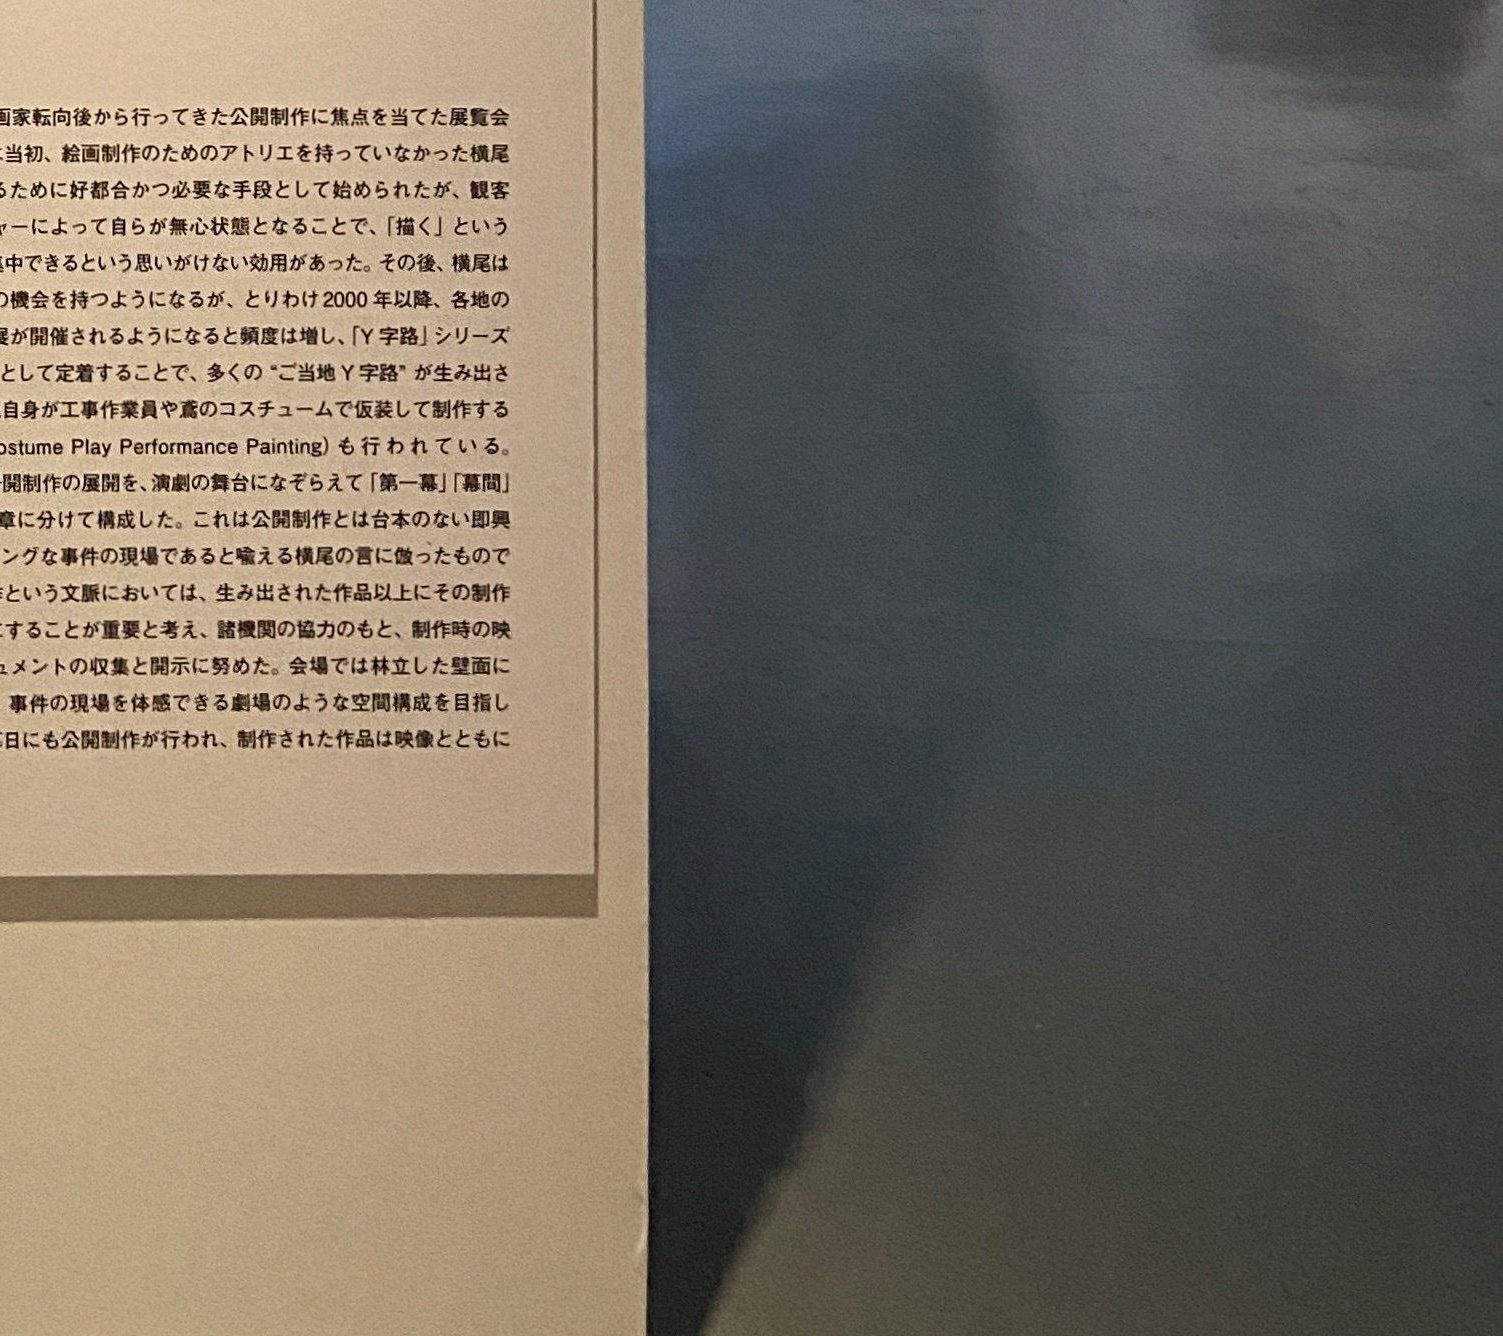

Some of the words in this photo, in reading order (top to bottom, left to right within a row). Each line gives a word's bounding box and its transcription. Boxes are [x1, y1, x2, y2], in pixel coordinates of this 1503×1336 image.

[72, 438, 111, 458] Play
[120, 438, 239, 457] Performance
[246, 437, 329, 458] Painting)
[337, 436, 510, 457] も行われている。
